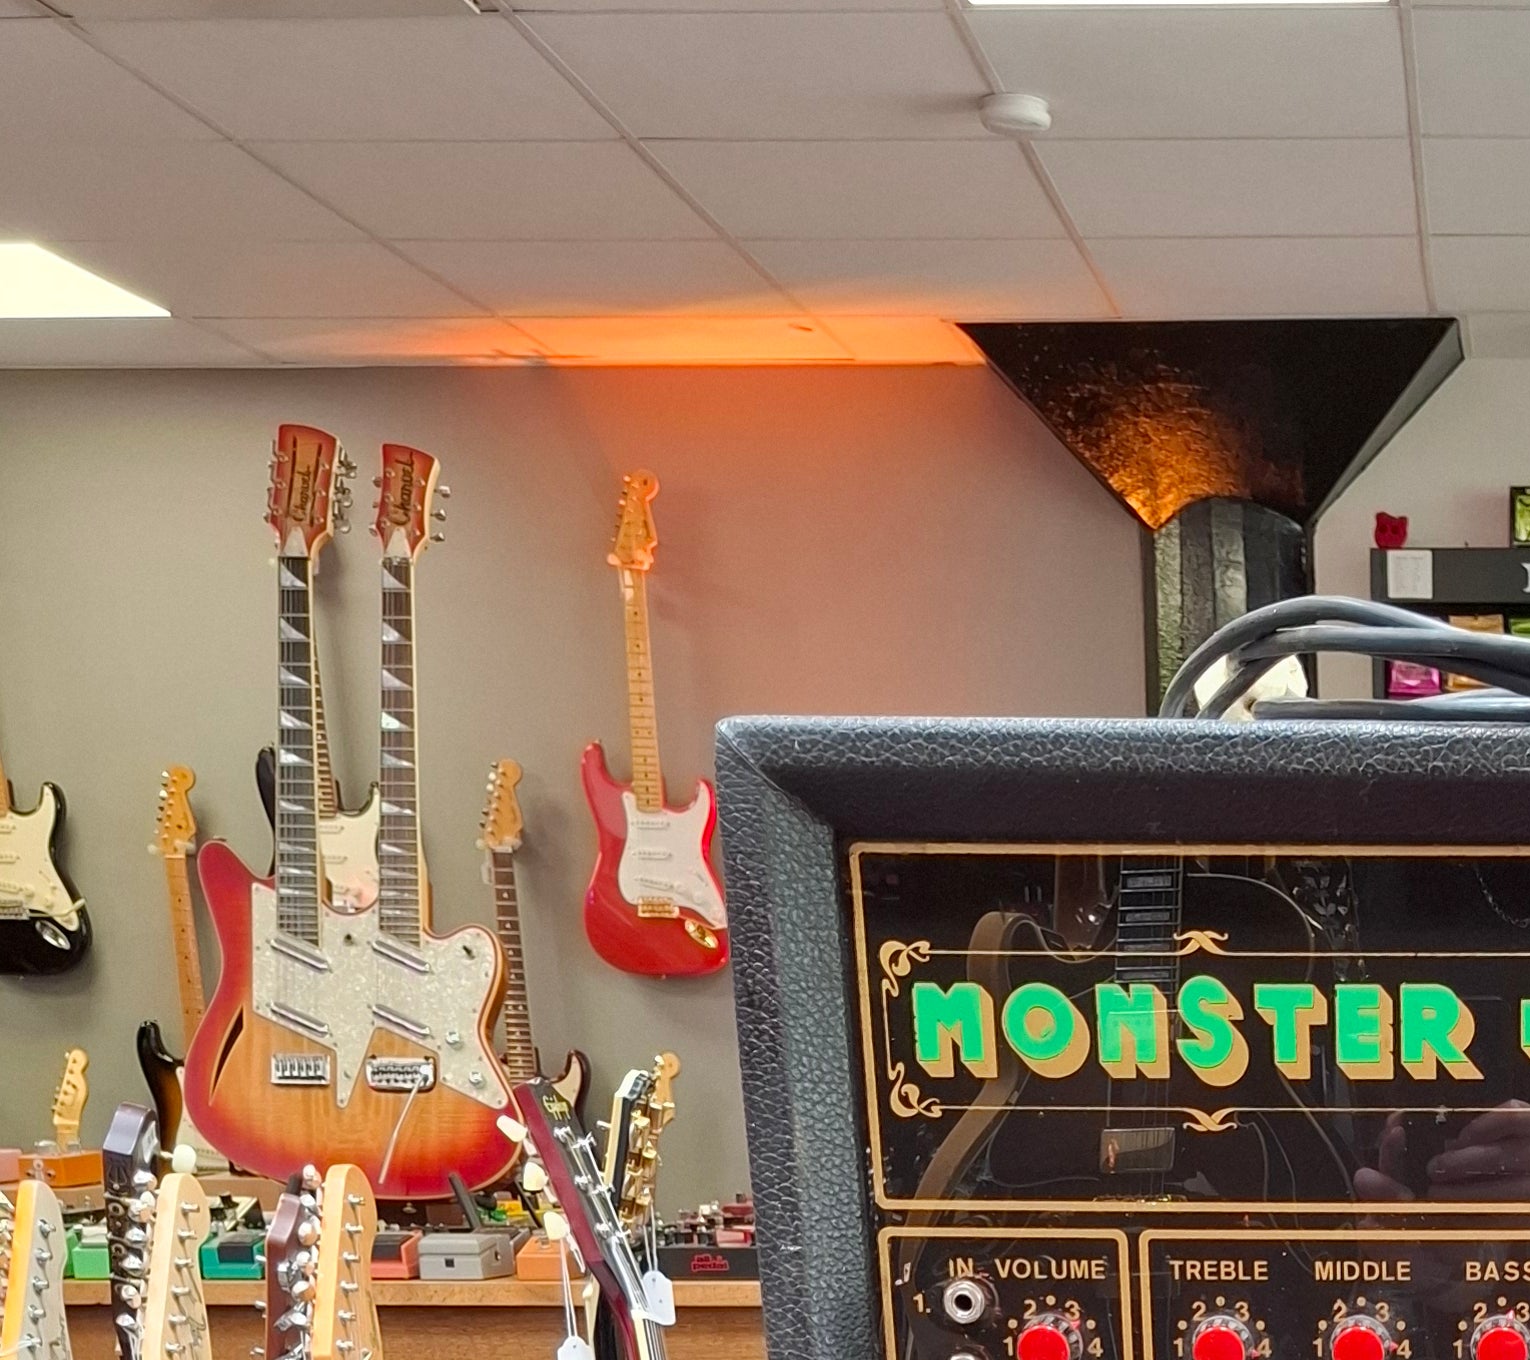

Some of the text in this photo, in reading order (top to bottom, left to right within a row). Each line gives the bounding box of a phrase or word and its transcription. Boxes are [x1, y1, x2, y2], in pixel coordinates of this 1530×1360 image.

[912, 975, 1483, 1086] MONSTER
[949, 1258, 973, 1277] IN
[995, 1258, 1106, 1280] VOLUME
[1169, 1260, 1269, 1281] TREBLE
[1314, 1260, 1411, 1281] MIDDLE
[913, 1293, 931, 1313] 1.
[1023, 1299, 1037, 1319] 2
[1065, 1300, 1081, 1320] 3
[1192, 1301, 1207, 1321] 2
[1235, 1301, 1250, 1321] 3
[1333, 1300, 1347, 1322] 2
[1375, 1302, 1390, 1322] 3
[1473, 1302, 1488, 1322] 2
[1516, 1302, 1530, 1322] 3
[1003, 1336, 1014, 1357] 1
[1088, 1337, 1104, 1358] 4
[1173, 1338, 1184, 1358] 1
[1257, 1338, 1272, 1358] 4
[1313, 1338, 1324, 1358] 1
[1396, 1339, 1412, 1359] 4
[1453, 1339, 1463, 1358] 1
